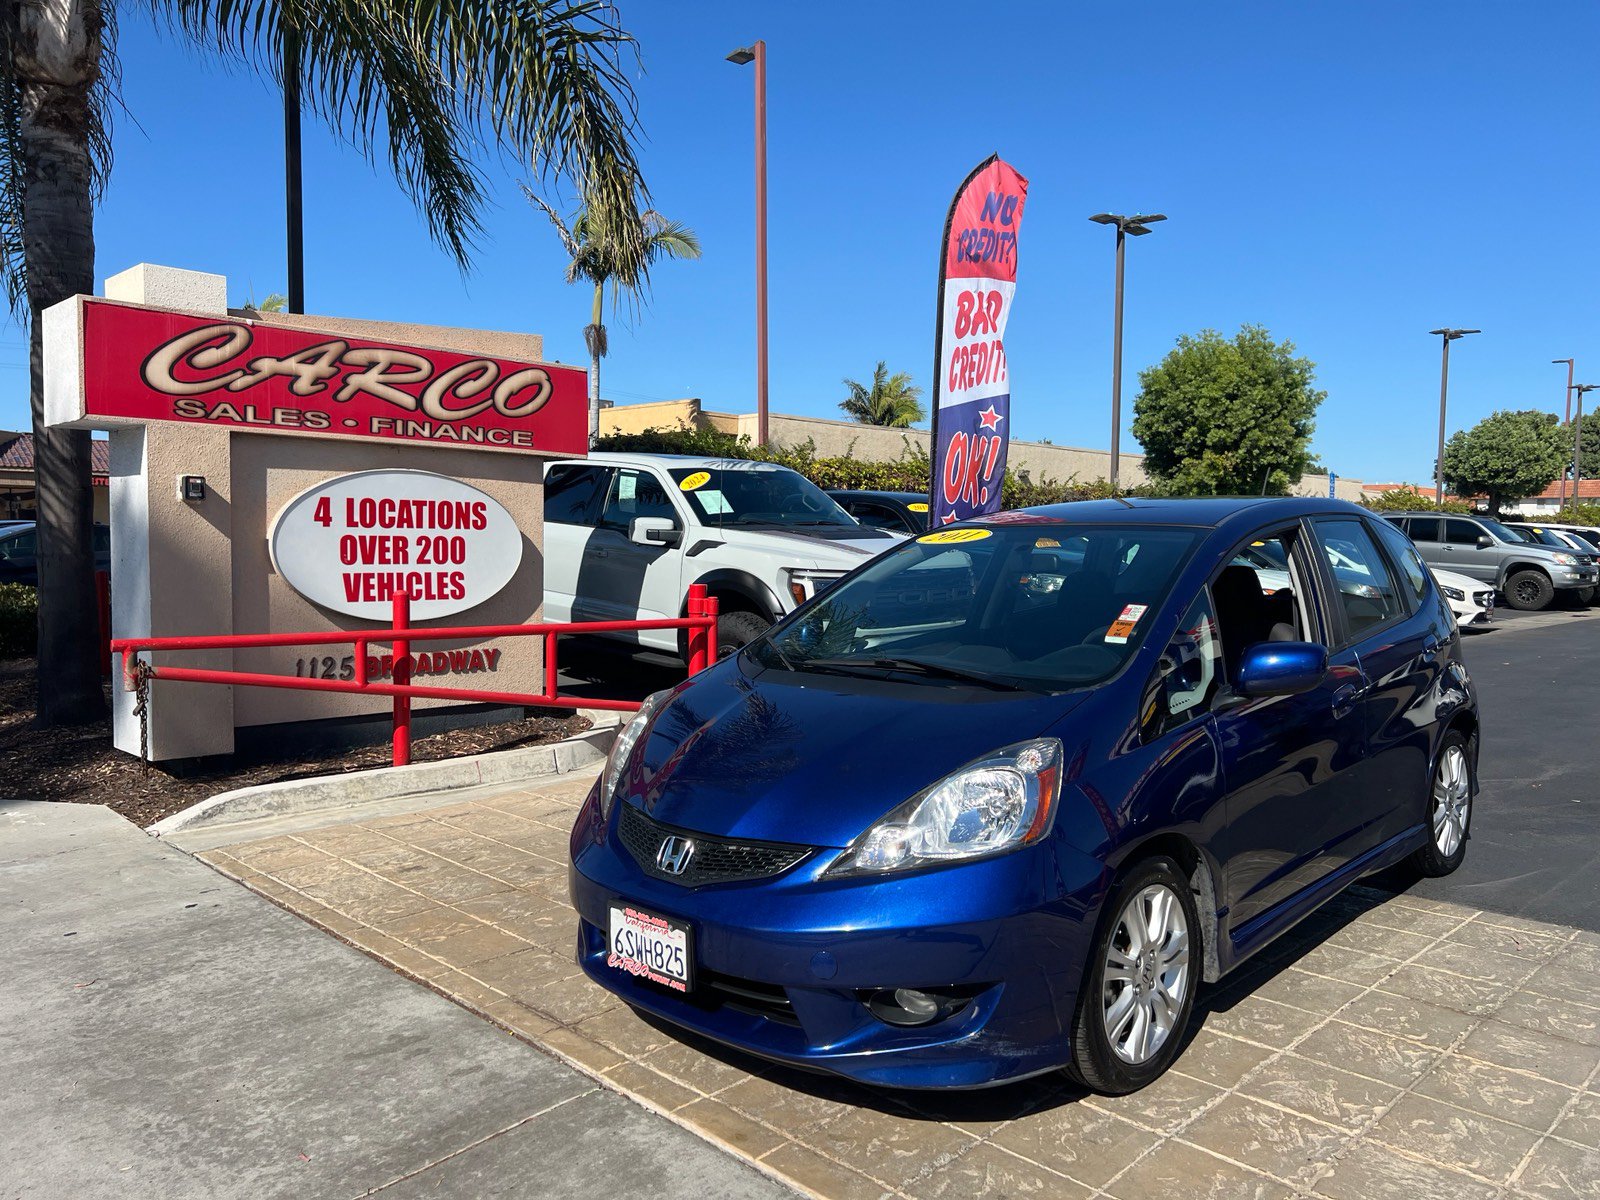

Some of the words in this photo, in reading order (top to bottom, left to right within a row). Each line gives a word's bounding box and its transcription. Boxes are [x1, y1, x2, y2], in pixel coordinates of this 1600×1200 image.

[980, 191, 1018, 226] NO
[957, 228, 1015, 263] CREDIT?
[955, 290, 1003, 339] BAD
[141, 323, 553, 421] CARCO
[174, 399, 332, 430] SALES
[370, 417, 534, 447] FINANCE
[685, 473, 706, 489] 2024
[943, 431, 1001, 509] OK!
[313, 497, 332, 527] 4
[346, 497, 487, 531] LOCATIONS
[340, 534, 409, 565] OVER
[416, 535, 466, 565] 200
[342, 571, 466, 603] VEHICLES
[295, 655, 355, 680] 1125
[367, 648, 501, 680] BRADWAY
[614, 927, 684, 977] 6SWH825
